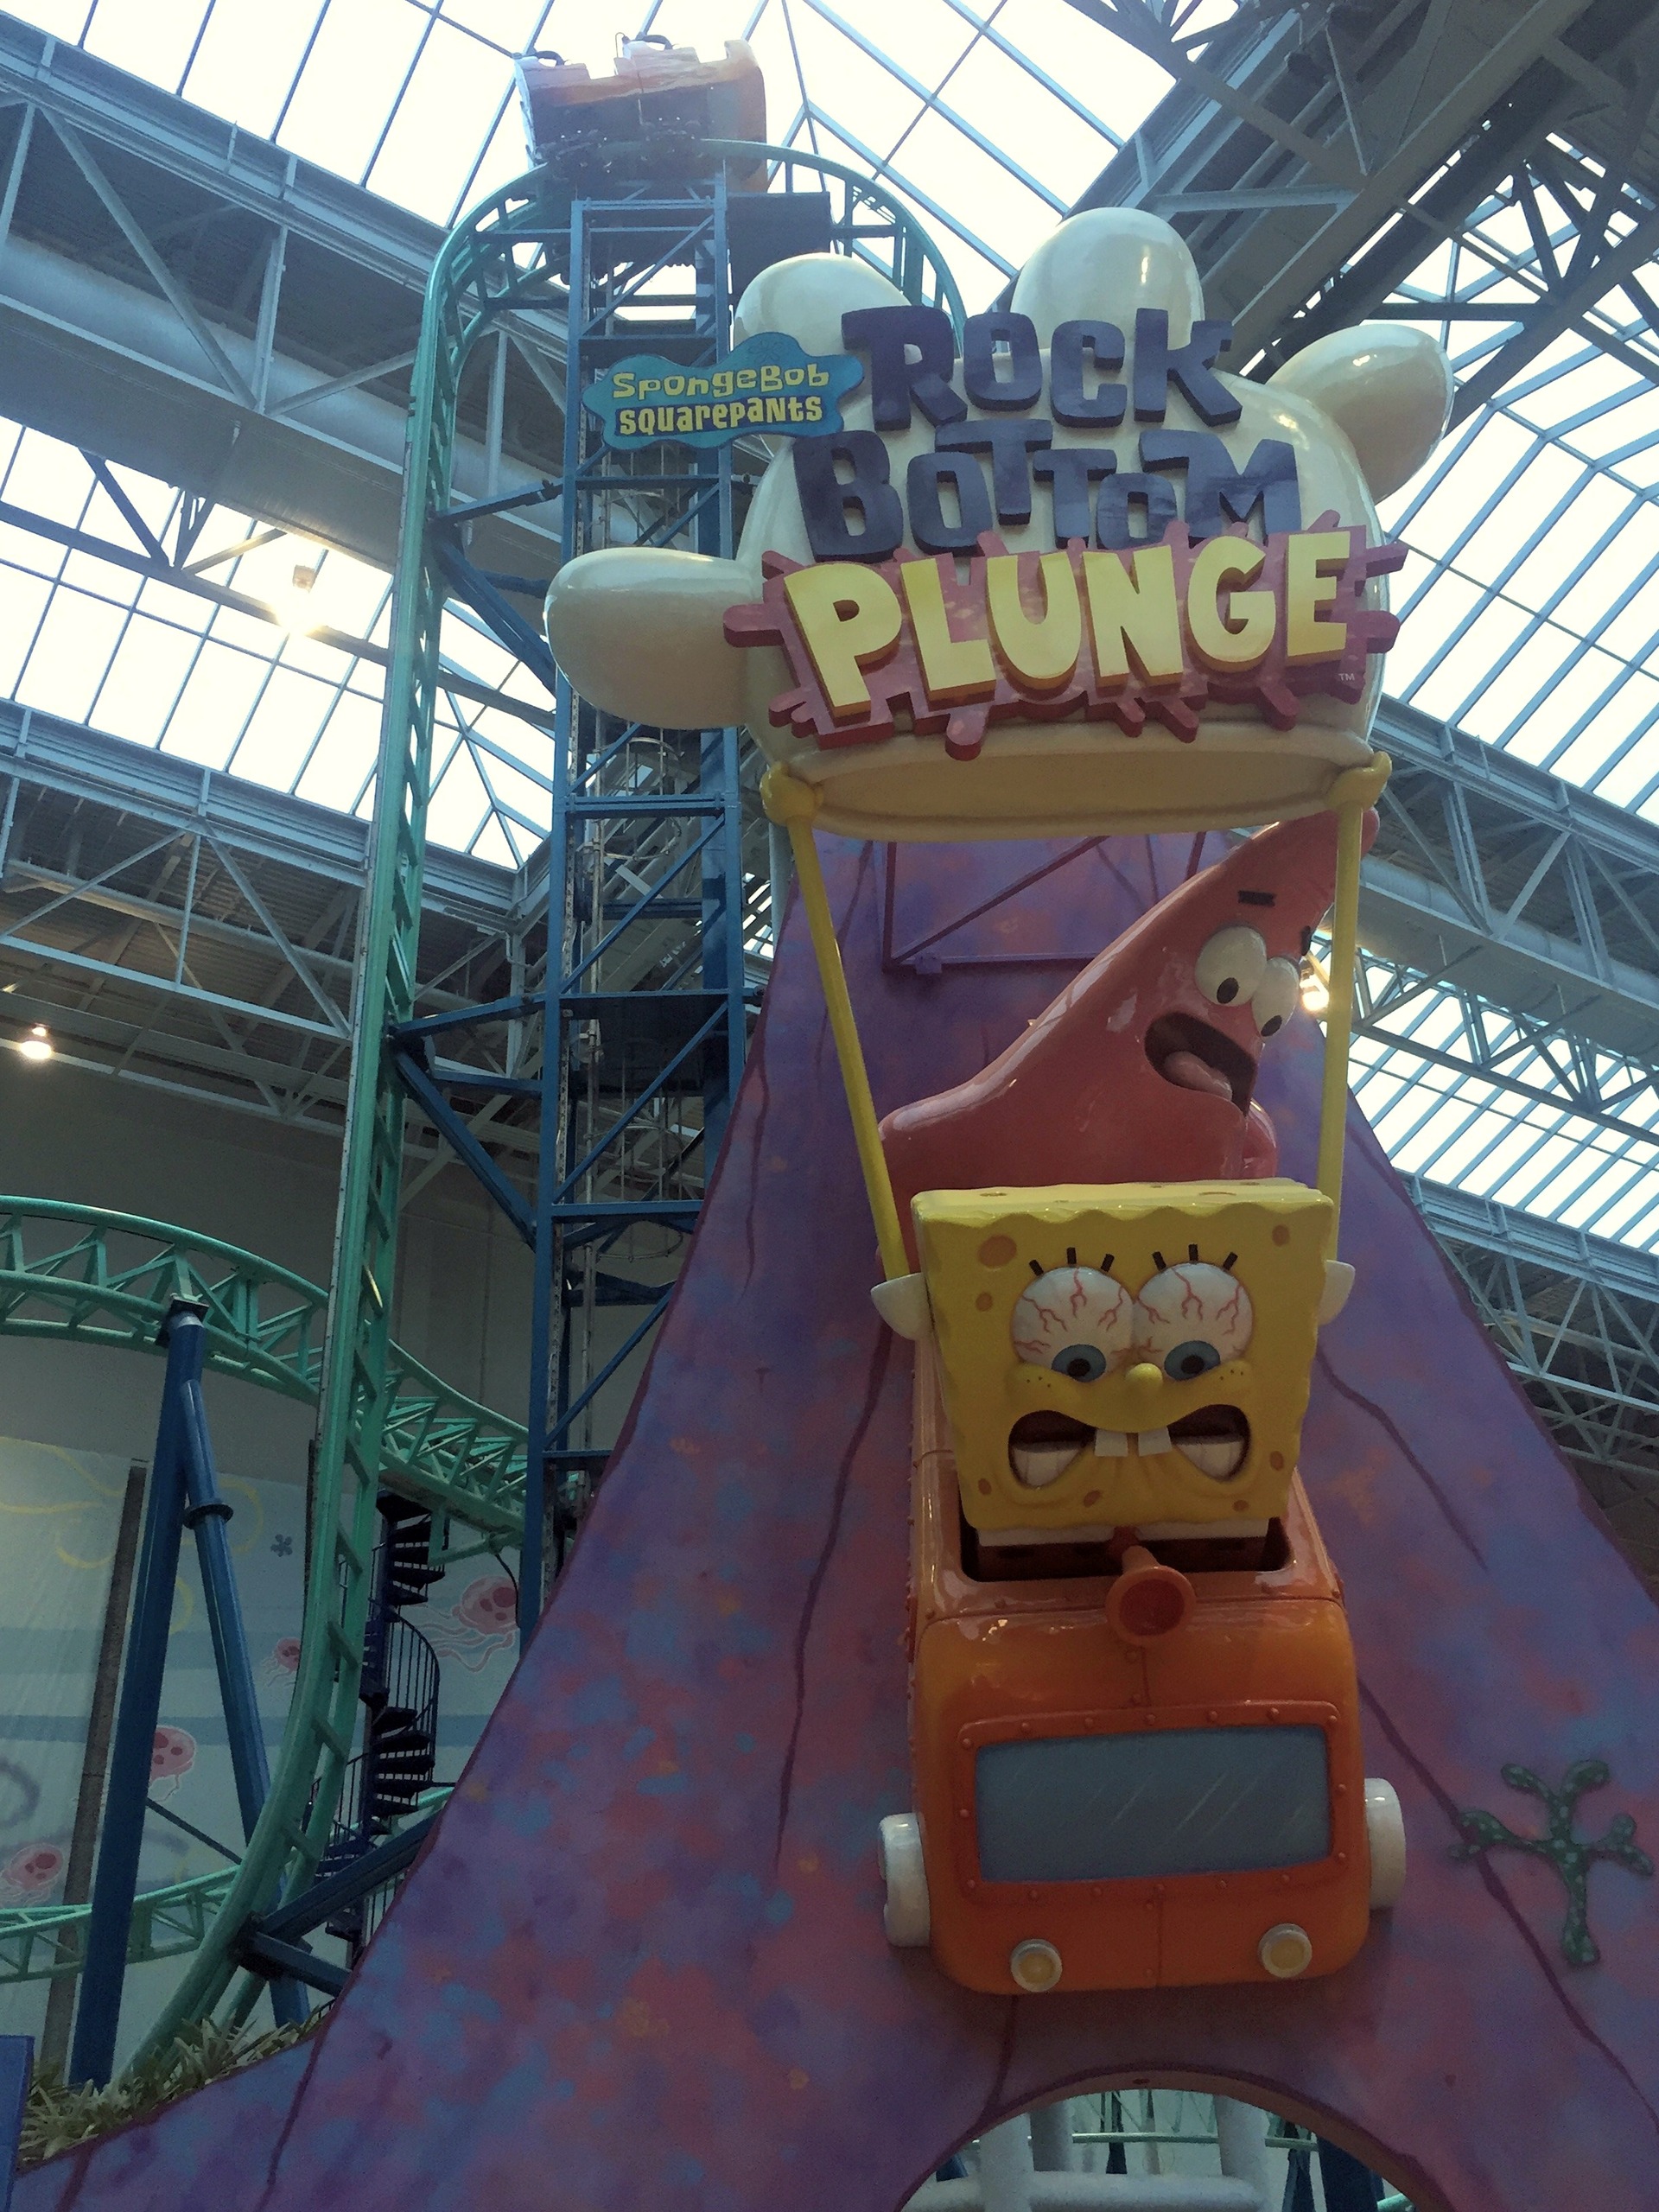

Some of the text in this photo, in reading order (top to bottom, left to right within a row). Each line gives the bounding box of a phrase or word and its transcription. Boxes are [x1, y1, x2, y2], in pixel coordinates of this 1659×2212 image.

[613, 364, 830, 400] SpongeBob
[842, 305, 1243, 431] ROCK
[791, 419, 1301, 563] BOTTOM
[784, 531, 1351, 719] PLUNGE
